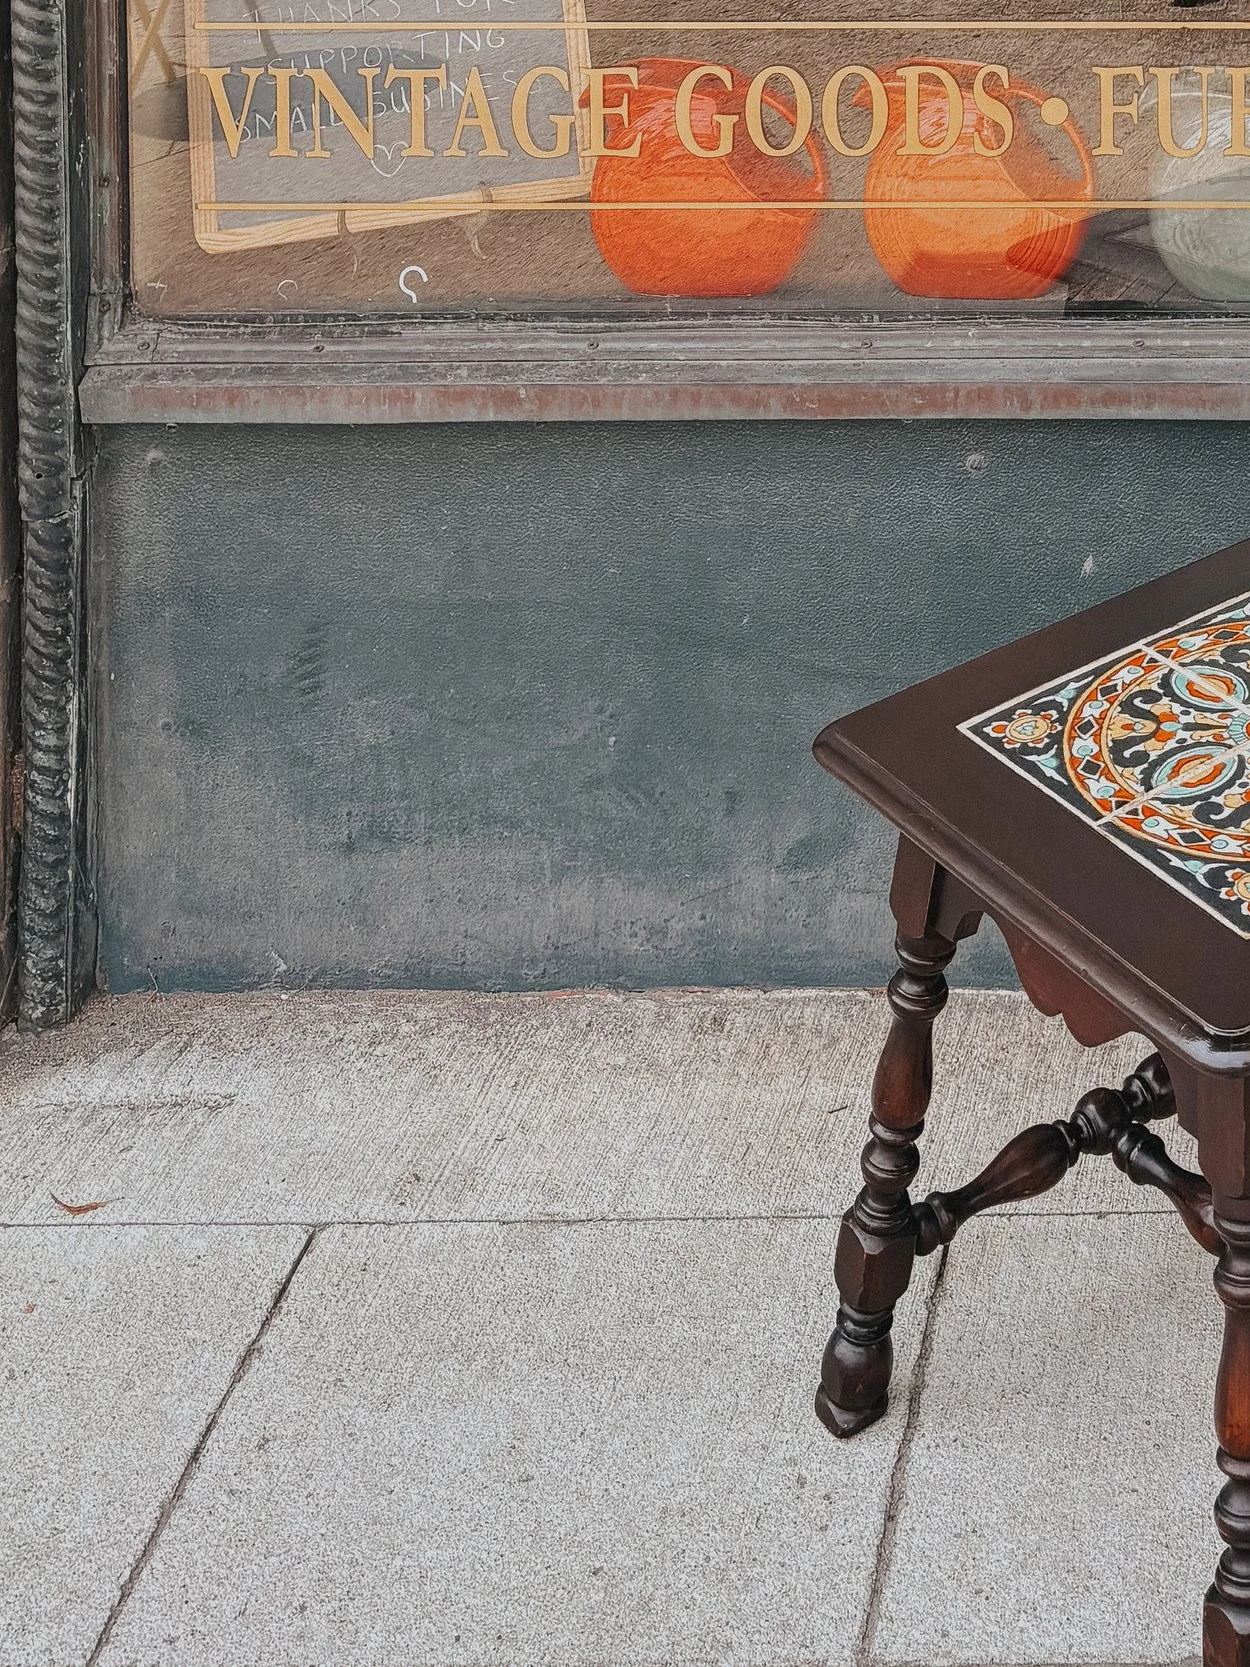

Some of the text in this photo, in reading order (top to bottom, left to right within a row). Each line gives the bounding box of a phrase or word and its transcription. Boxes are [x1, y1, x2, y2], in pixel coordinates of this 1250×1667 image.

[265, 28, 506, 85] SUPPORTING
[201, 63, 642, 160] VINTAGE
[676, 63, 1016, 160] GOODS
